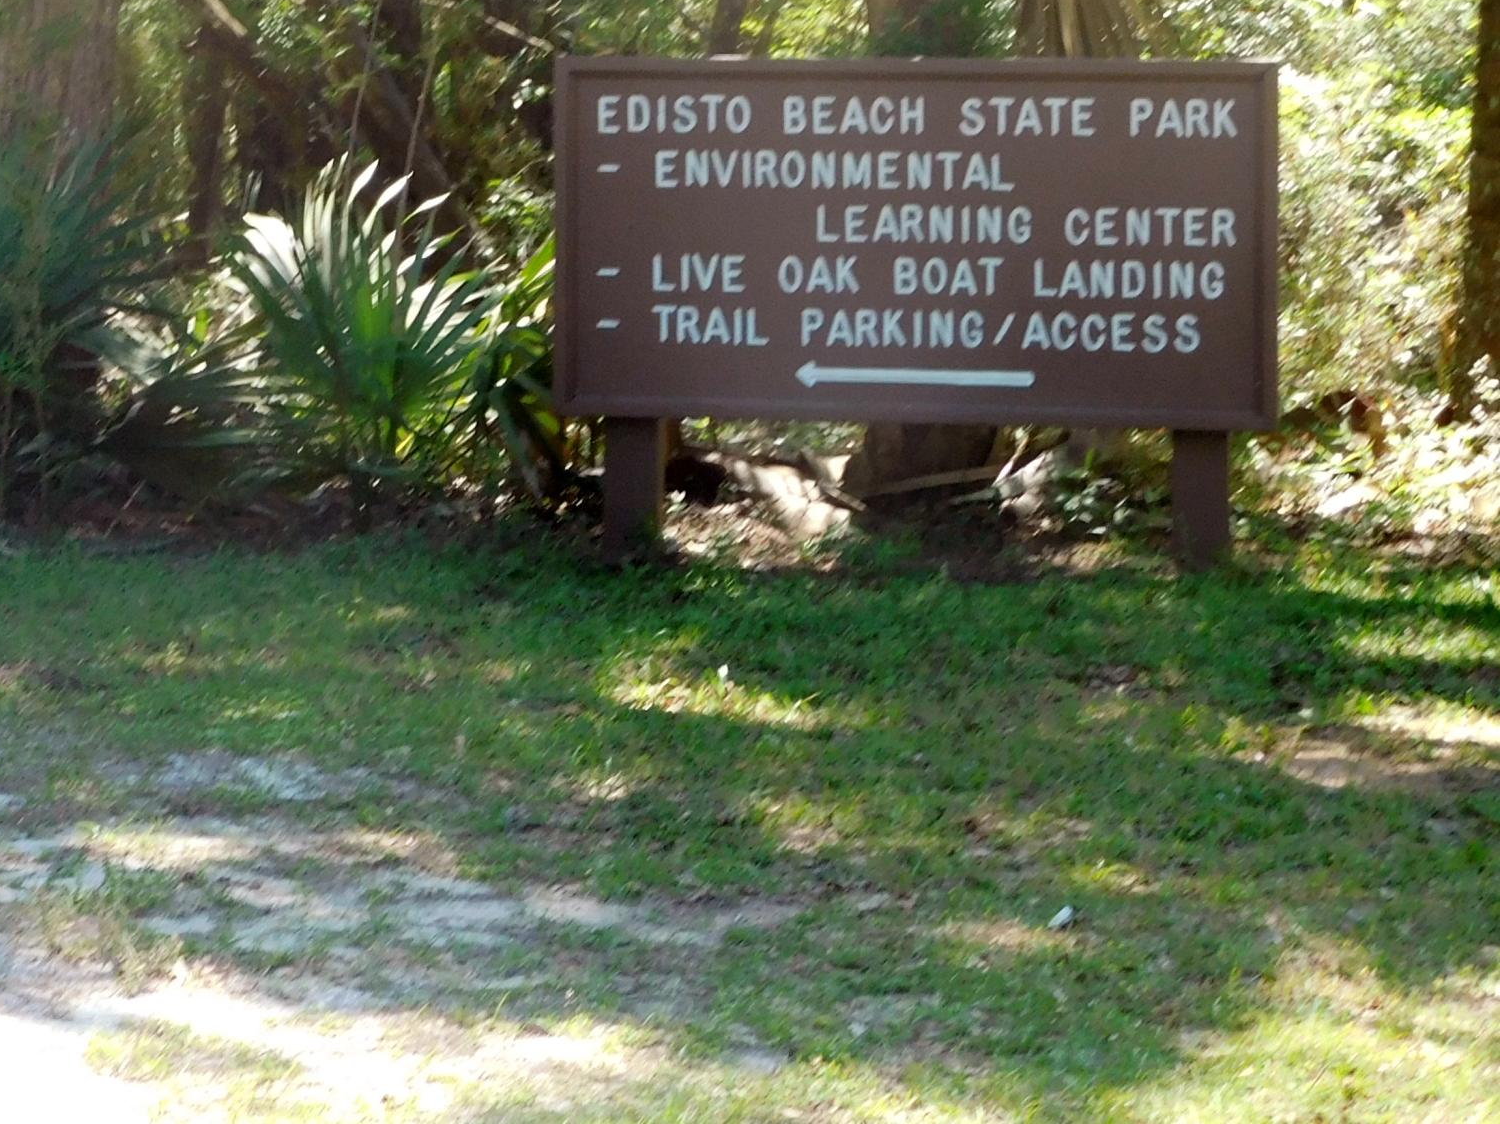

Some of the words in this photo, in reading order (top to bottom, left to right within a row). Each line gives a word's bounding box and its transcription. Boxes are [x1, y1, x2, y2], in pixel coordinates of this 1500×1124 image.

[597, 93, 752, 134] EDISTO
[783, 95, 925, 135] BEACH
[958, 96, 1095, 137] STATE
[1129, 98, 1238, 139] PARK
[655, 149, 1015, 192] ENVIRONMENTAL
[816, 203, 1032, 244] LEARNING
[1064, 207, 1237, 247] CENTER
[652, 252, 746, 293] LIVE
[777, 255, 860, 294] OAK
[893, 256, 1004, 296] BOAT
[1033, 258, 1225, 300] LANDING
[651, 304, 770, 346] TRAIL
[800, 307, 1201, 353] PARKING/ACCESS
